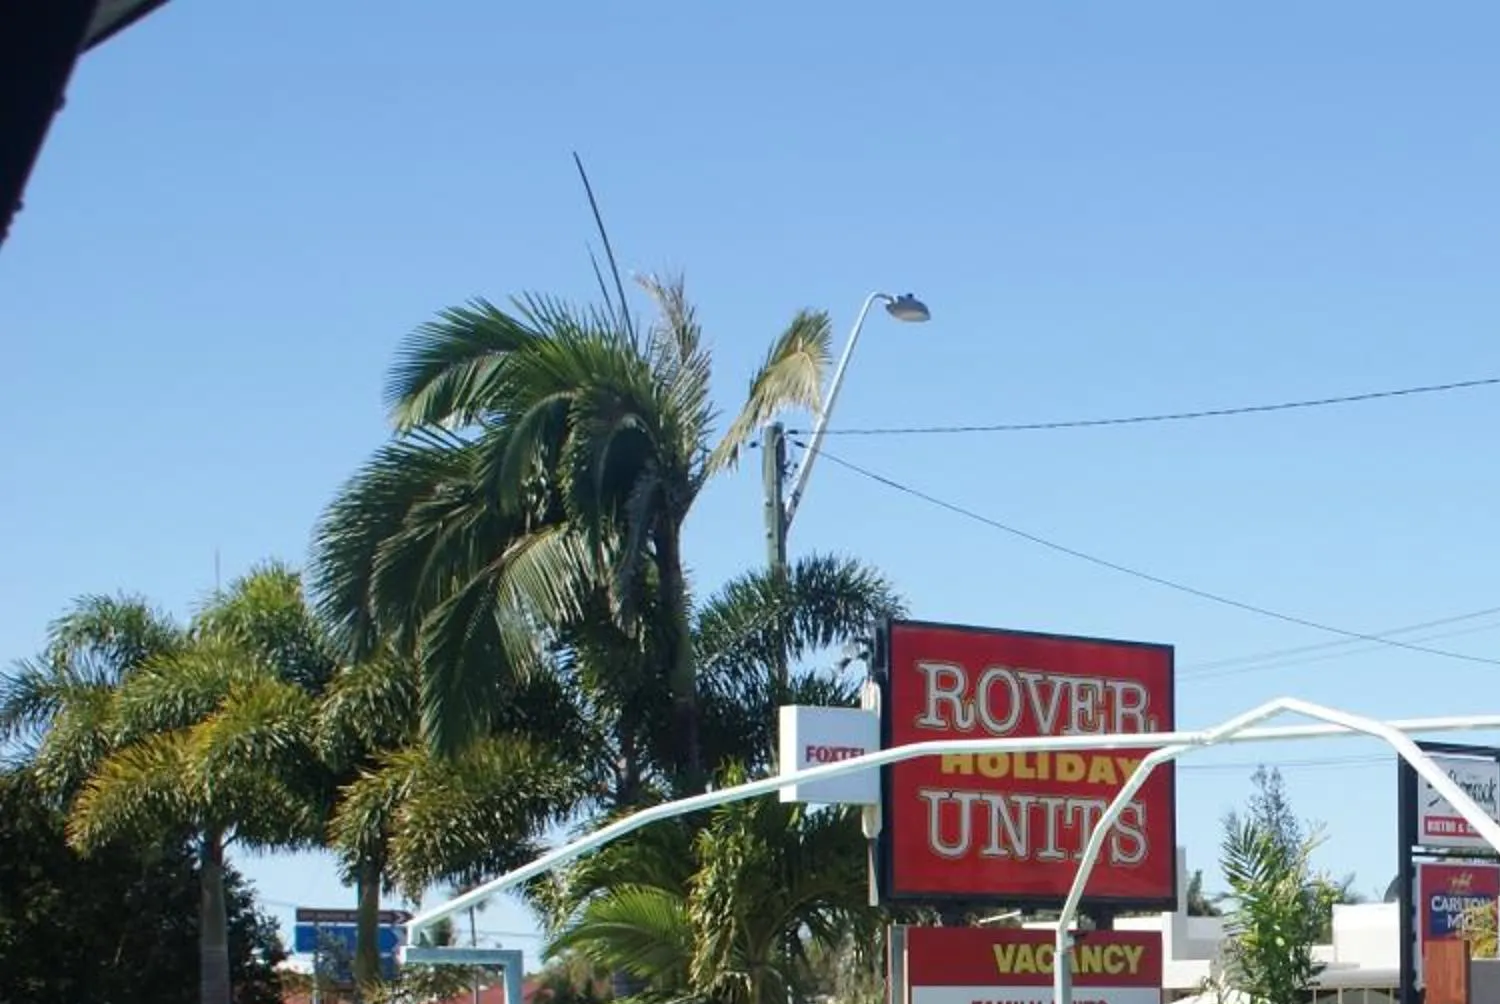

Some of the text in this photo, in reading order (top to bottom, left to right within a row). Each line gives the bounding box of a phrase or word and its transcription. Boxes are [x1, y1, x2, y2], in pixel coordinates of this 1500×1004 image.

[914, 660, 1157, 735] ROVER
[940, 752, 1142, 785] HOLIDAY
[918, 788, 1149, 866] UNITS
[1431, 895, 1492, 913] CARLTON
